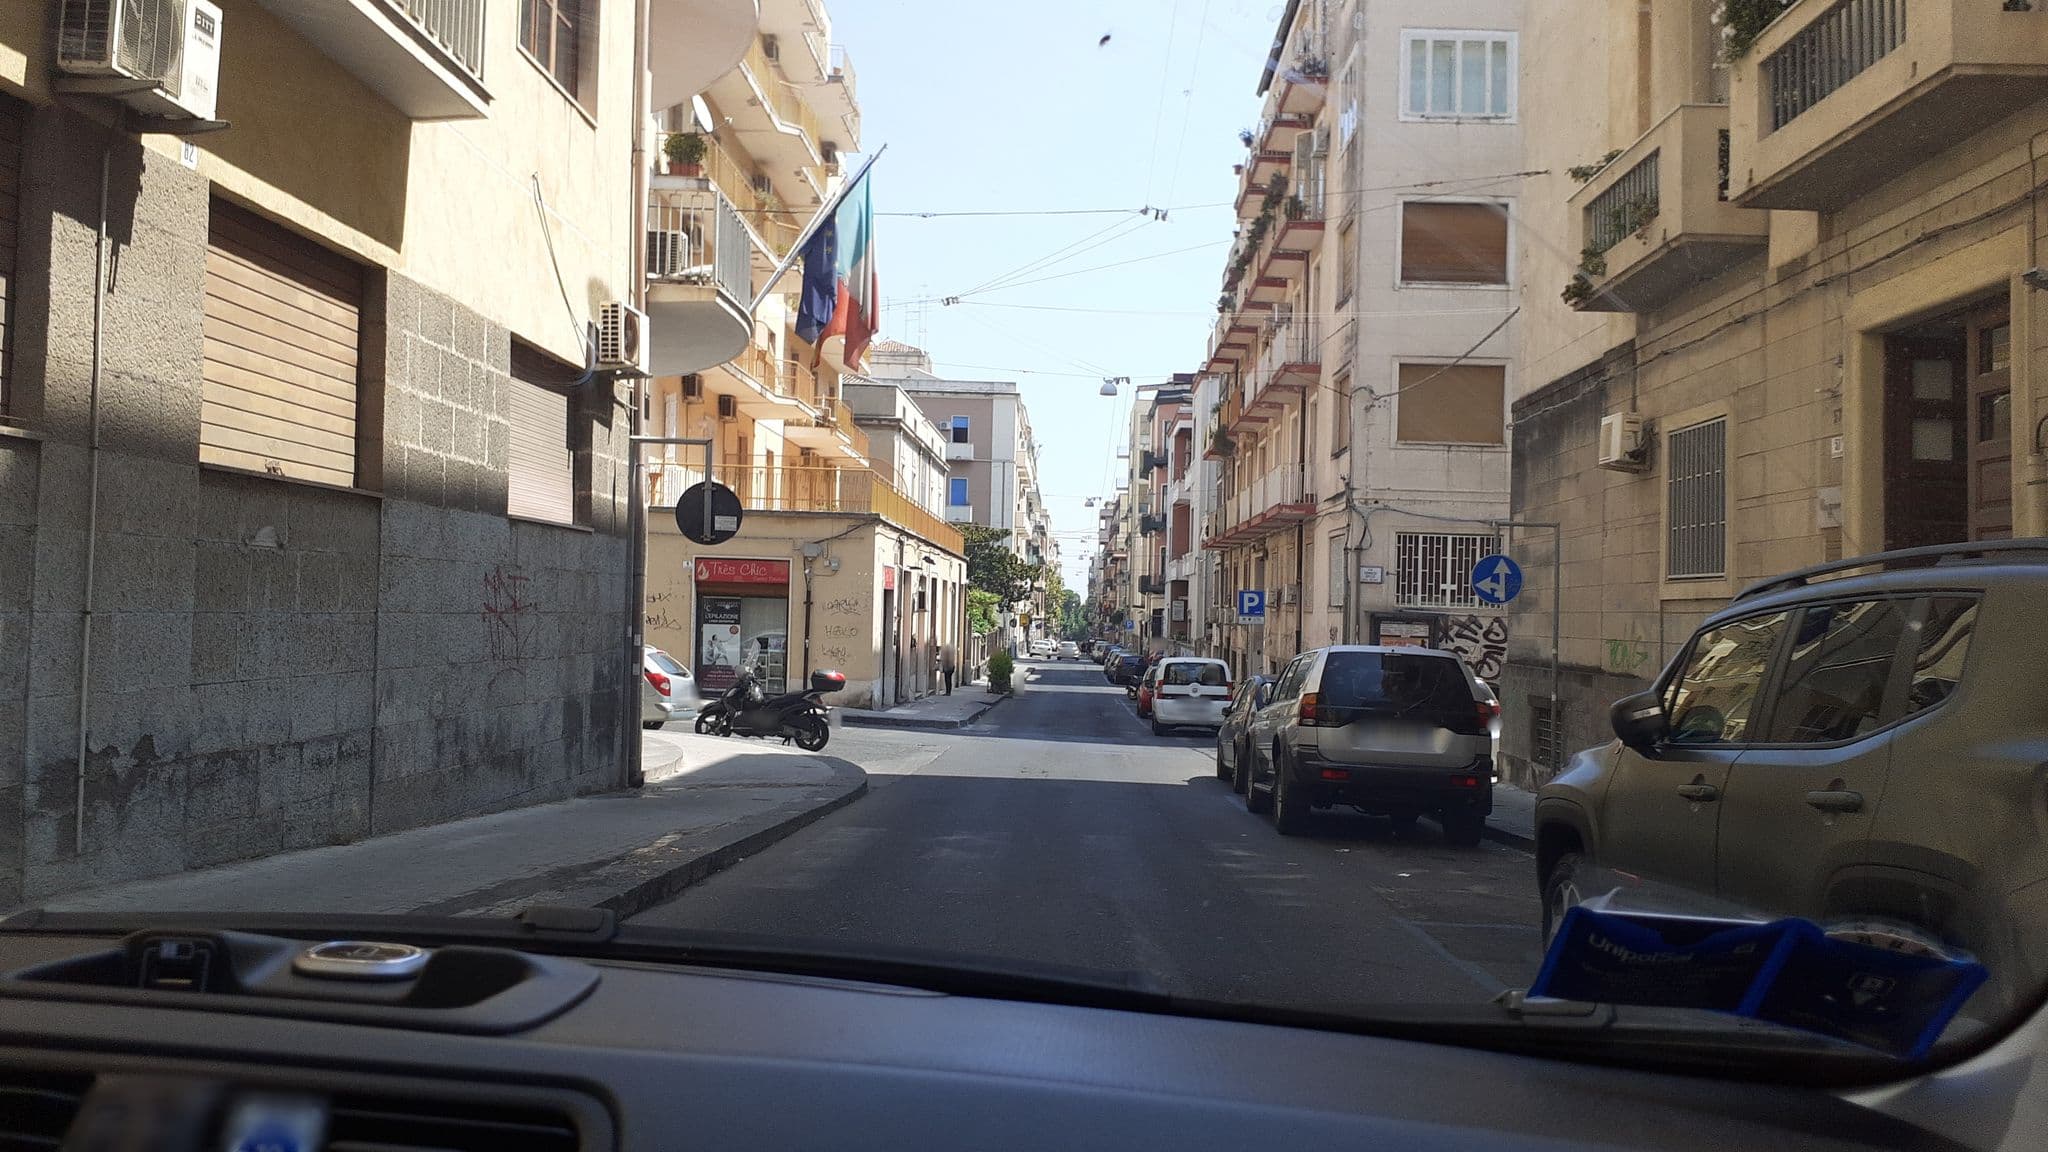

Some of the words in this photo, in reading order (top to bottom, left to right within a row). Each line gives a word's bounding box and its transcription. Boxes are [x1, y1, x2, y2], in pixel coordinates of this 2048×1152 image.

[709, 561, 736, 575] Très
[739, 563, 769, 576] Chic
[1243, 592, 1259, 613] P
